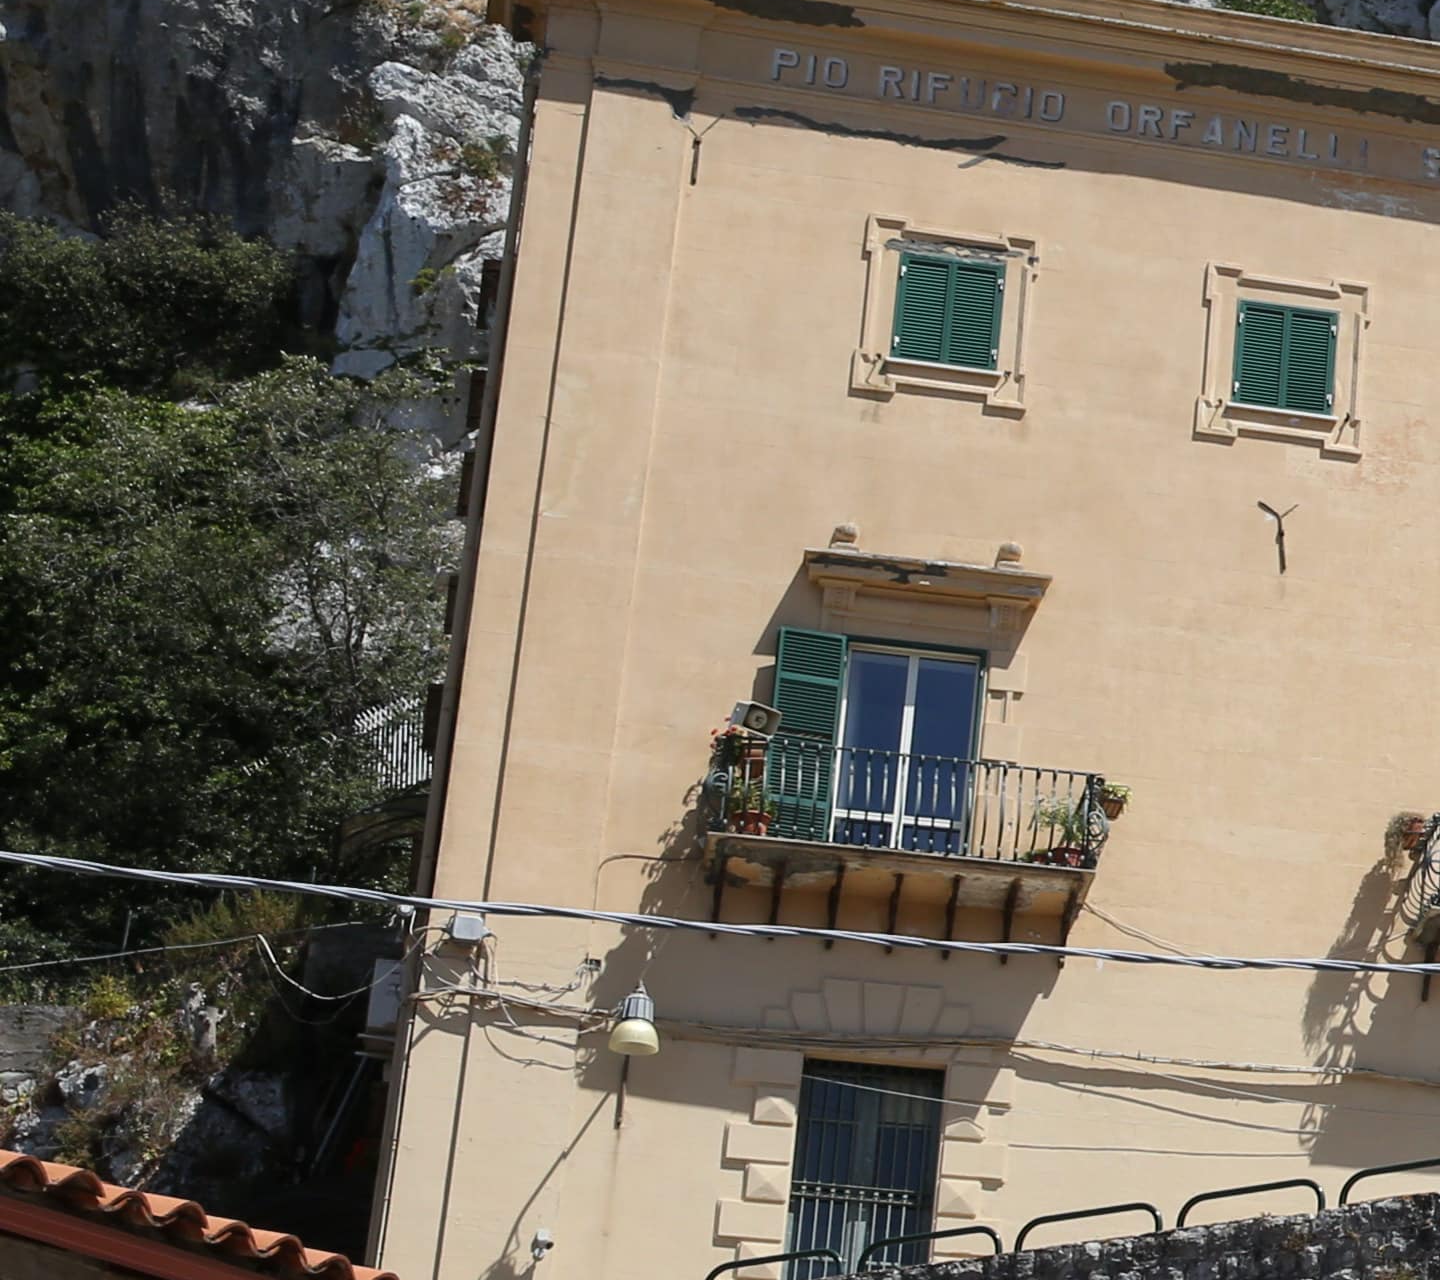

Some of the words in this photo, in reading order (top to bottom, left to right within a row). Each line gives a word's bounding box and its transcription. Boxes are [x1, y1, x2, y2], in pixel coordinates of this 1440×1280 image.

[772, 48, 849, 90] PIO
[879, 65, 1065, 122] RIFUGIO
[1106, 99, 1369, 169] ORFANELLI
